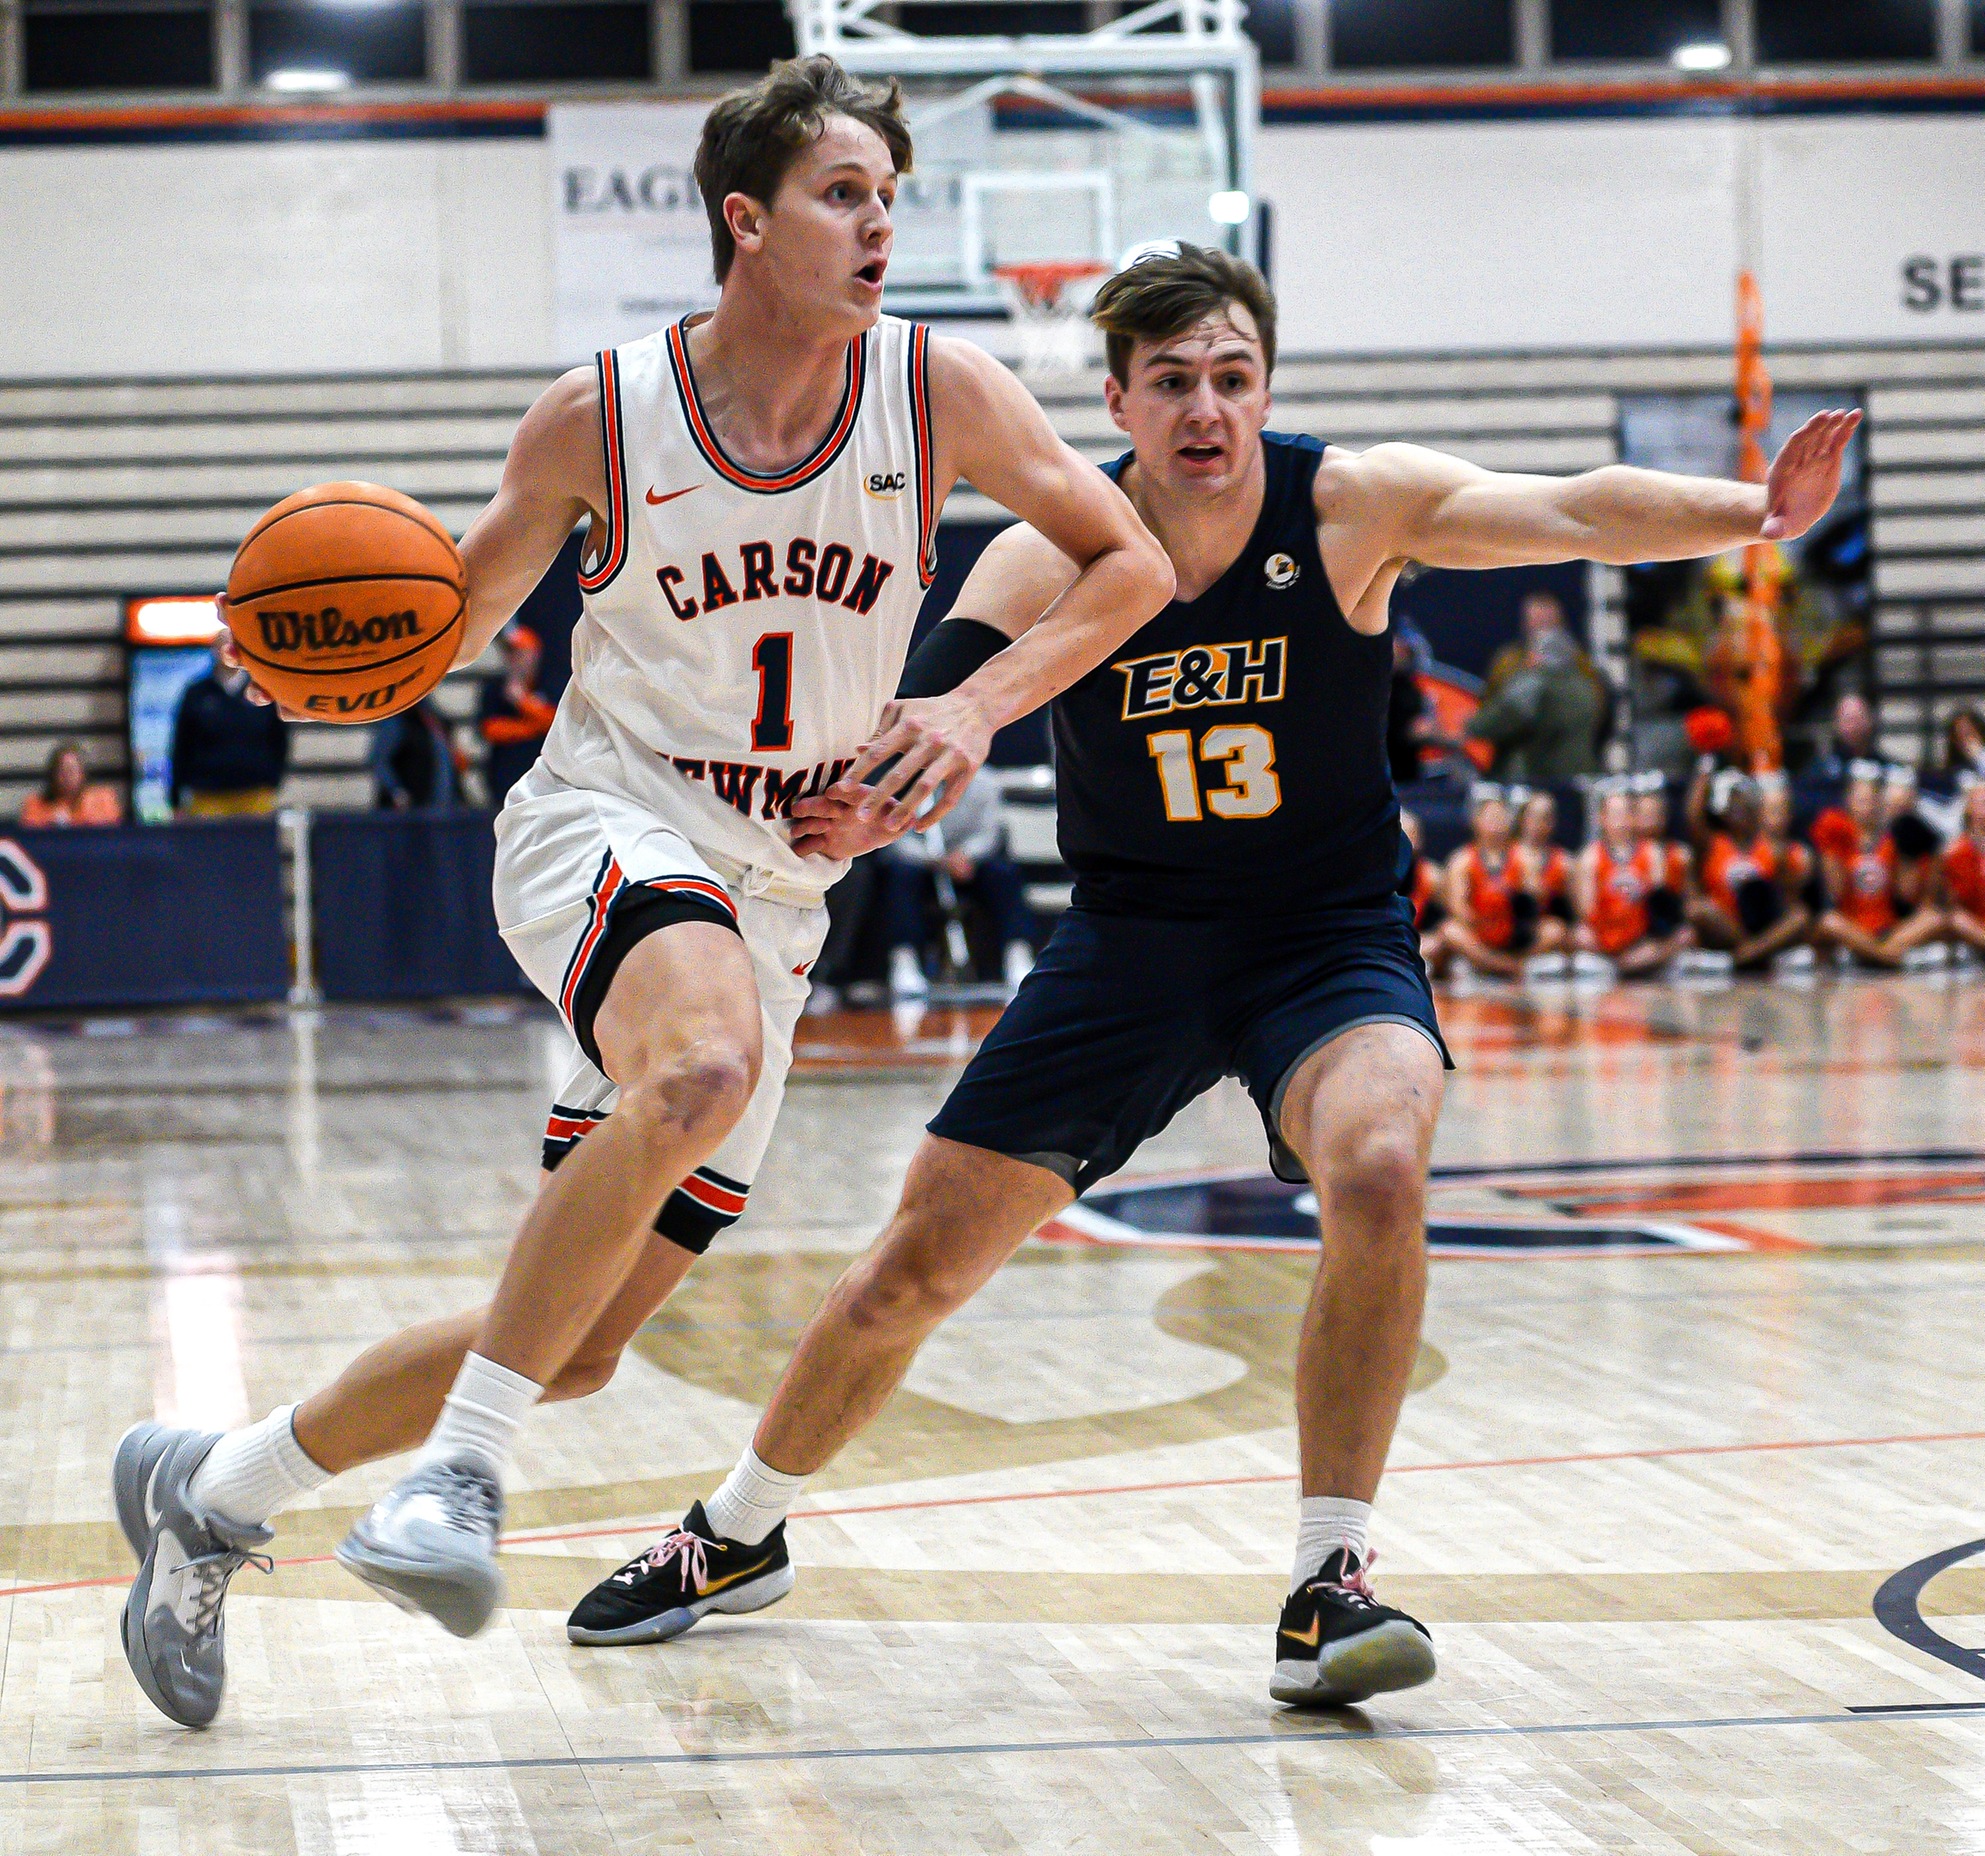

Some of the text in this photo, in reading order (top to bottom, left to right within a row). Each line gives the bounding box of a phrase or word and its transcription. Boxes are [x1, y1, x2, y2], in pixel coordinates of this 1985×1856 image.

[870, 471, 906, 492] SAC
[656, 537, 894, 622] CARSON
[257, 607, 423, 651] Wilson
[304, 684, 396, 713] EVO
[750, 631, 794, 752] 1
[1110, 635, 1288, 721] E&H
[1146, 723, 1282, 821] 13
